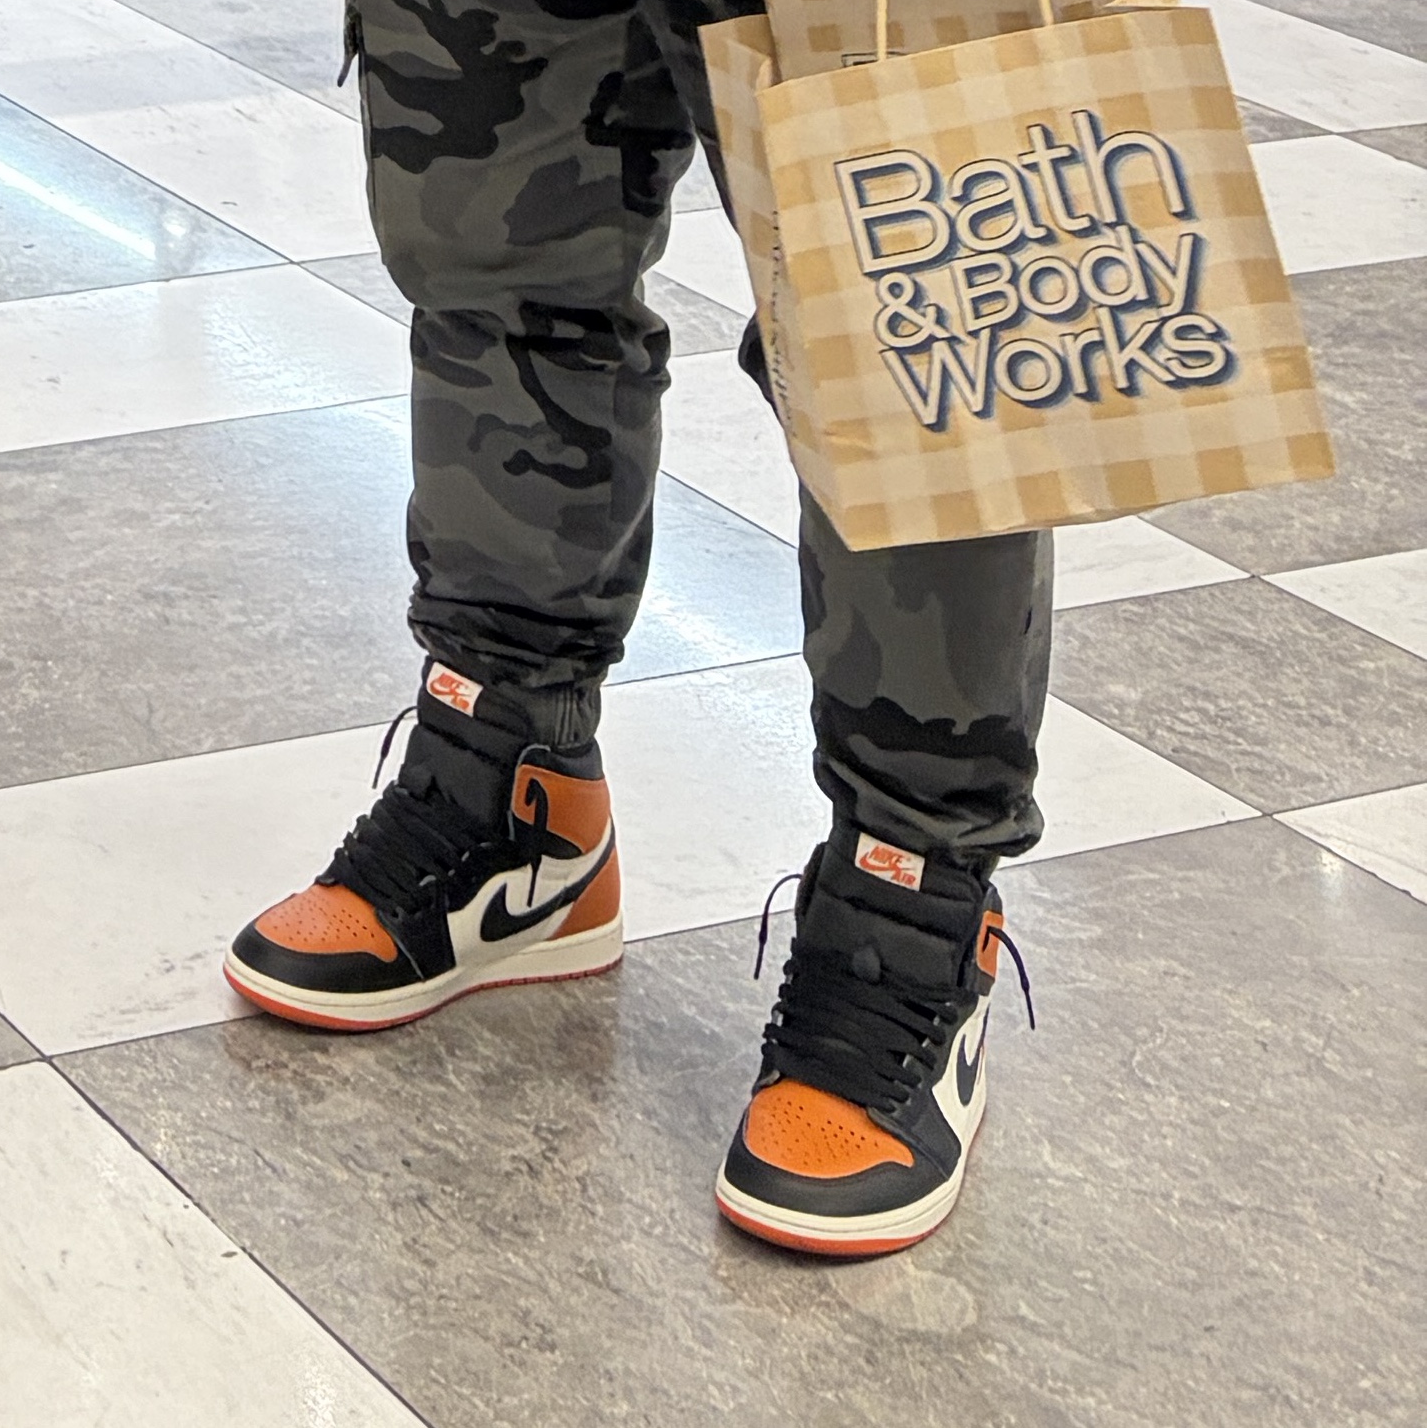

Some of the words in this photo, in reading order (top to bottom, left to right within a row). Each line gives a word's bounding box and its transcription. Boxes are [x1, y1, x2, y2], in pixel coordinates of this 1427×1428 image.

[833, 108, 1191, 275] Bath
[874, 273, 956, 351] &
[951, 224, 1200, 333] Body
[878, 305, 1231, 427] Works
